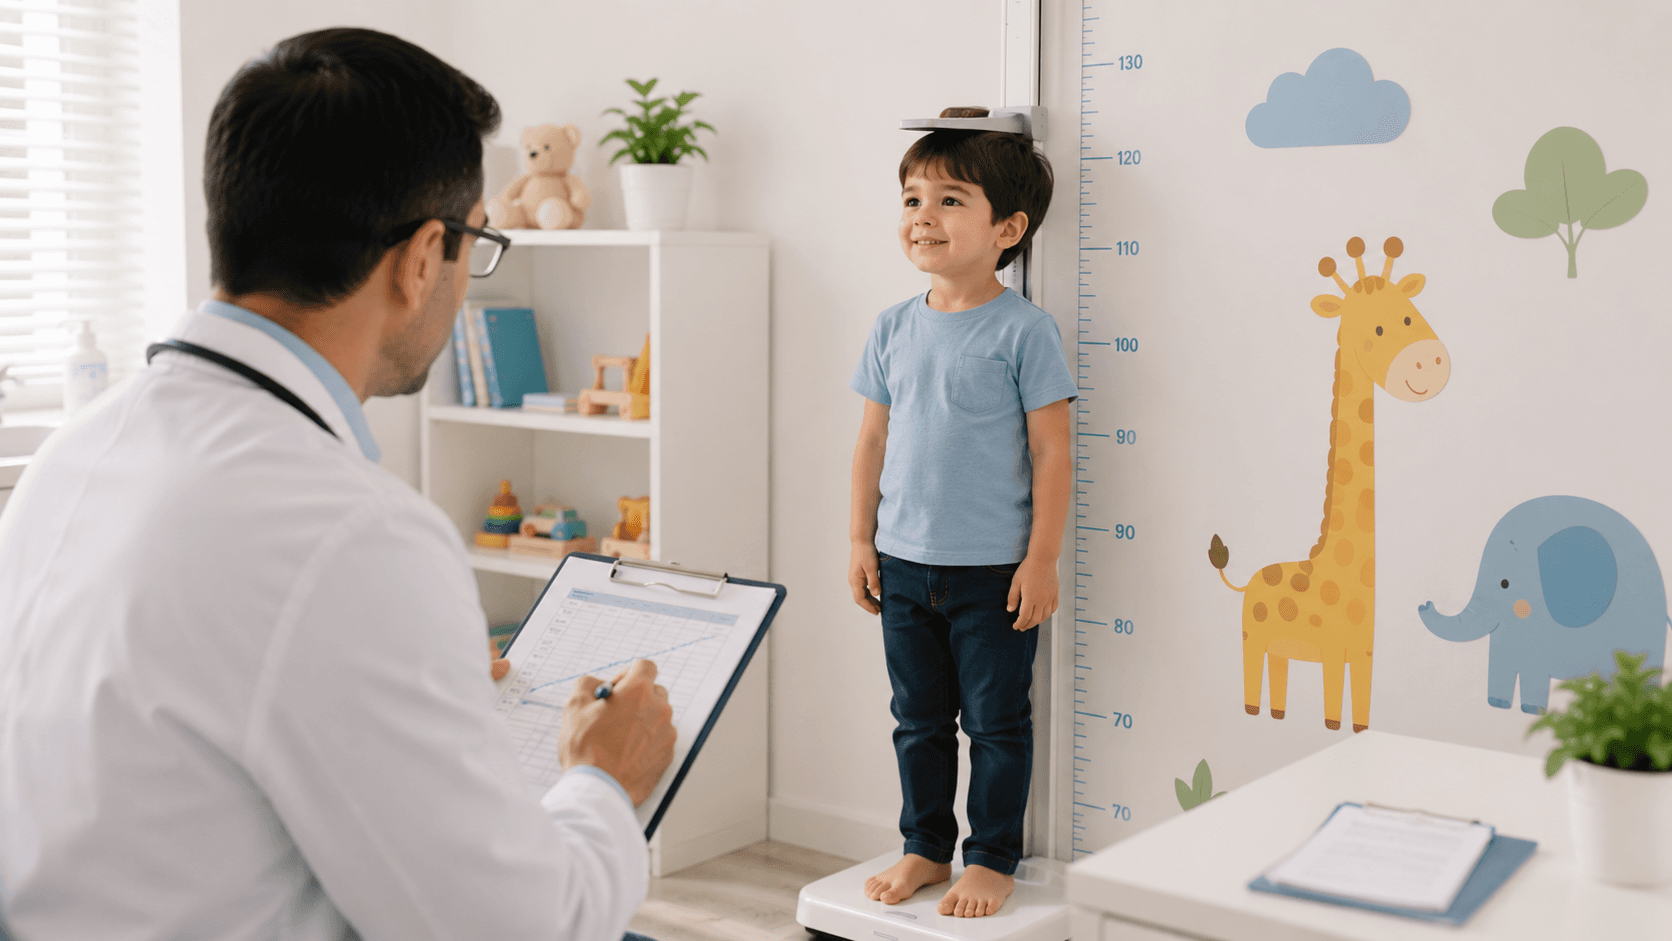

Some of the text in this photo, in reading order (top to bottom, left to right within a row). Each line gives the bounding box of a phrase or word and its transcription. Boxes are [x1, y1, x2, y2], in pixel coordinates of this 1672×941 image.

[1118, 54, 1143, 71] 130
[1117, 150, 1141, 166] 120
[1116, 240, 1139, 256] 110
[1114, 337, 1139, 353] 100
[1116, 428, 1136, 446] 90
[1115, 523, 1136, 541] 90
[1114, 618, 1134, 635] 80
[1113, 711, 1133, 729] 70
[1112, 803, 1131, 821] 70
